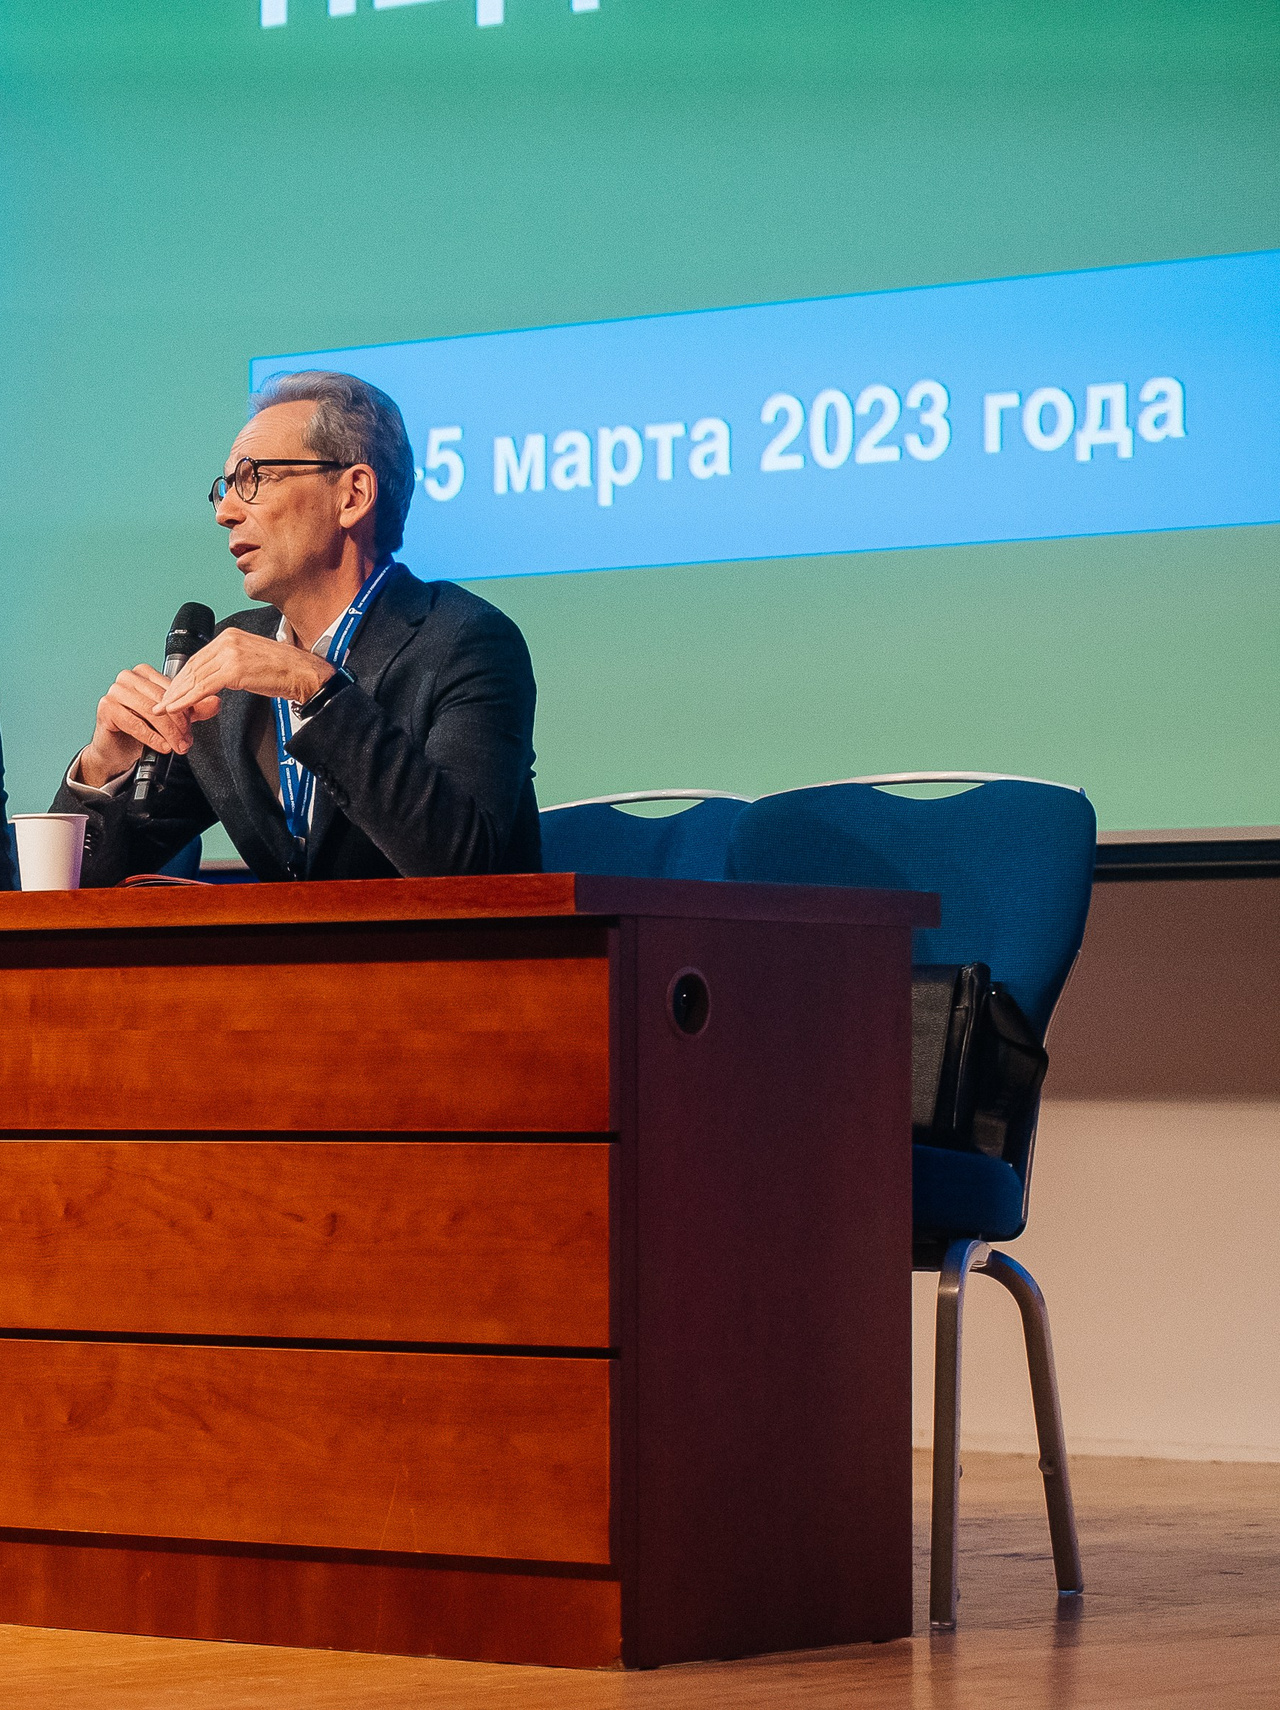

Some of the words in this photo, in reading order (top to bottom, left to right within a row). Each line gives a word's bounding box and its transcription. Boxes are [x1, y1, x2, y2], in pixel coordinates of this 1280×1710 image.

[493, 417, 731, 507] марта
[760, 380, 951, 472] 2023
[984, 376, 1186, 462] года
